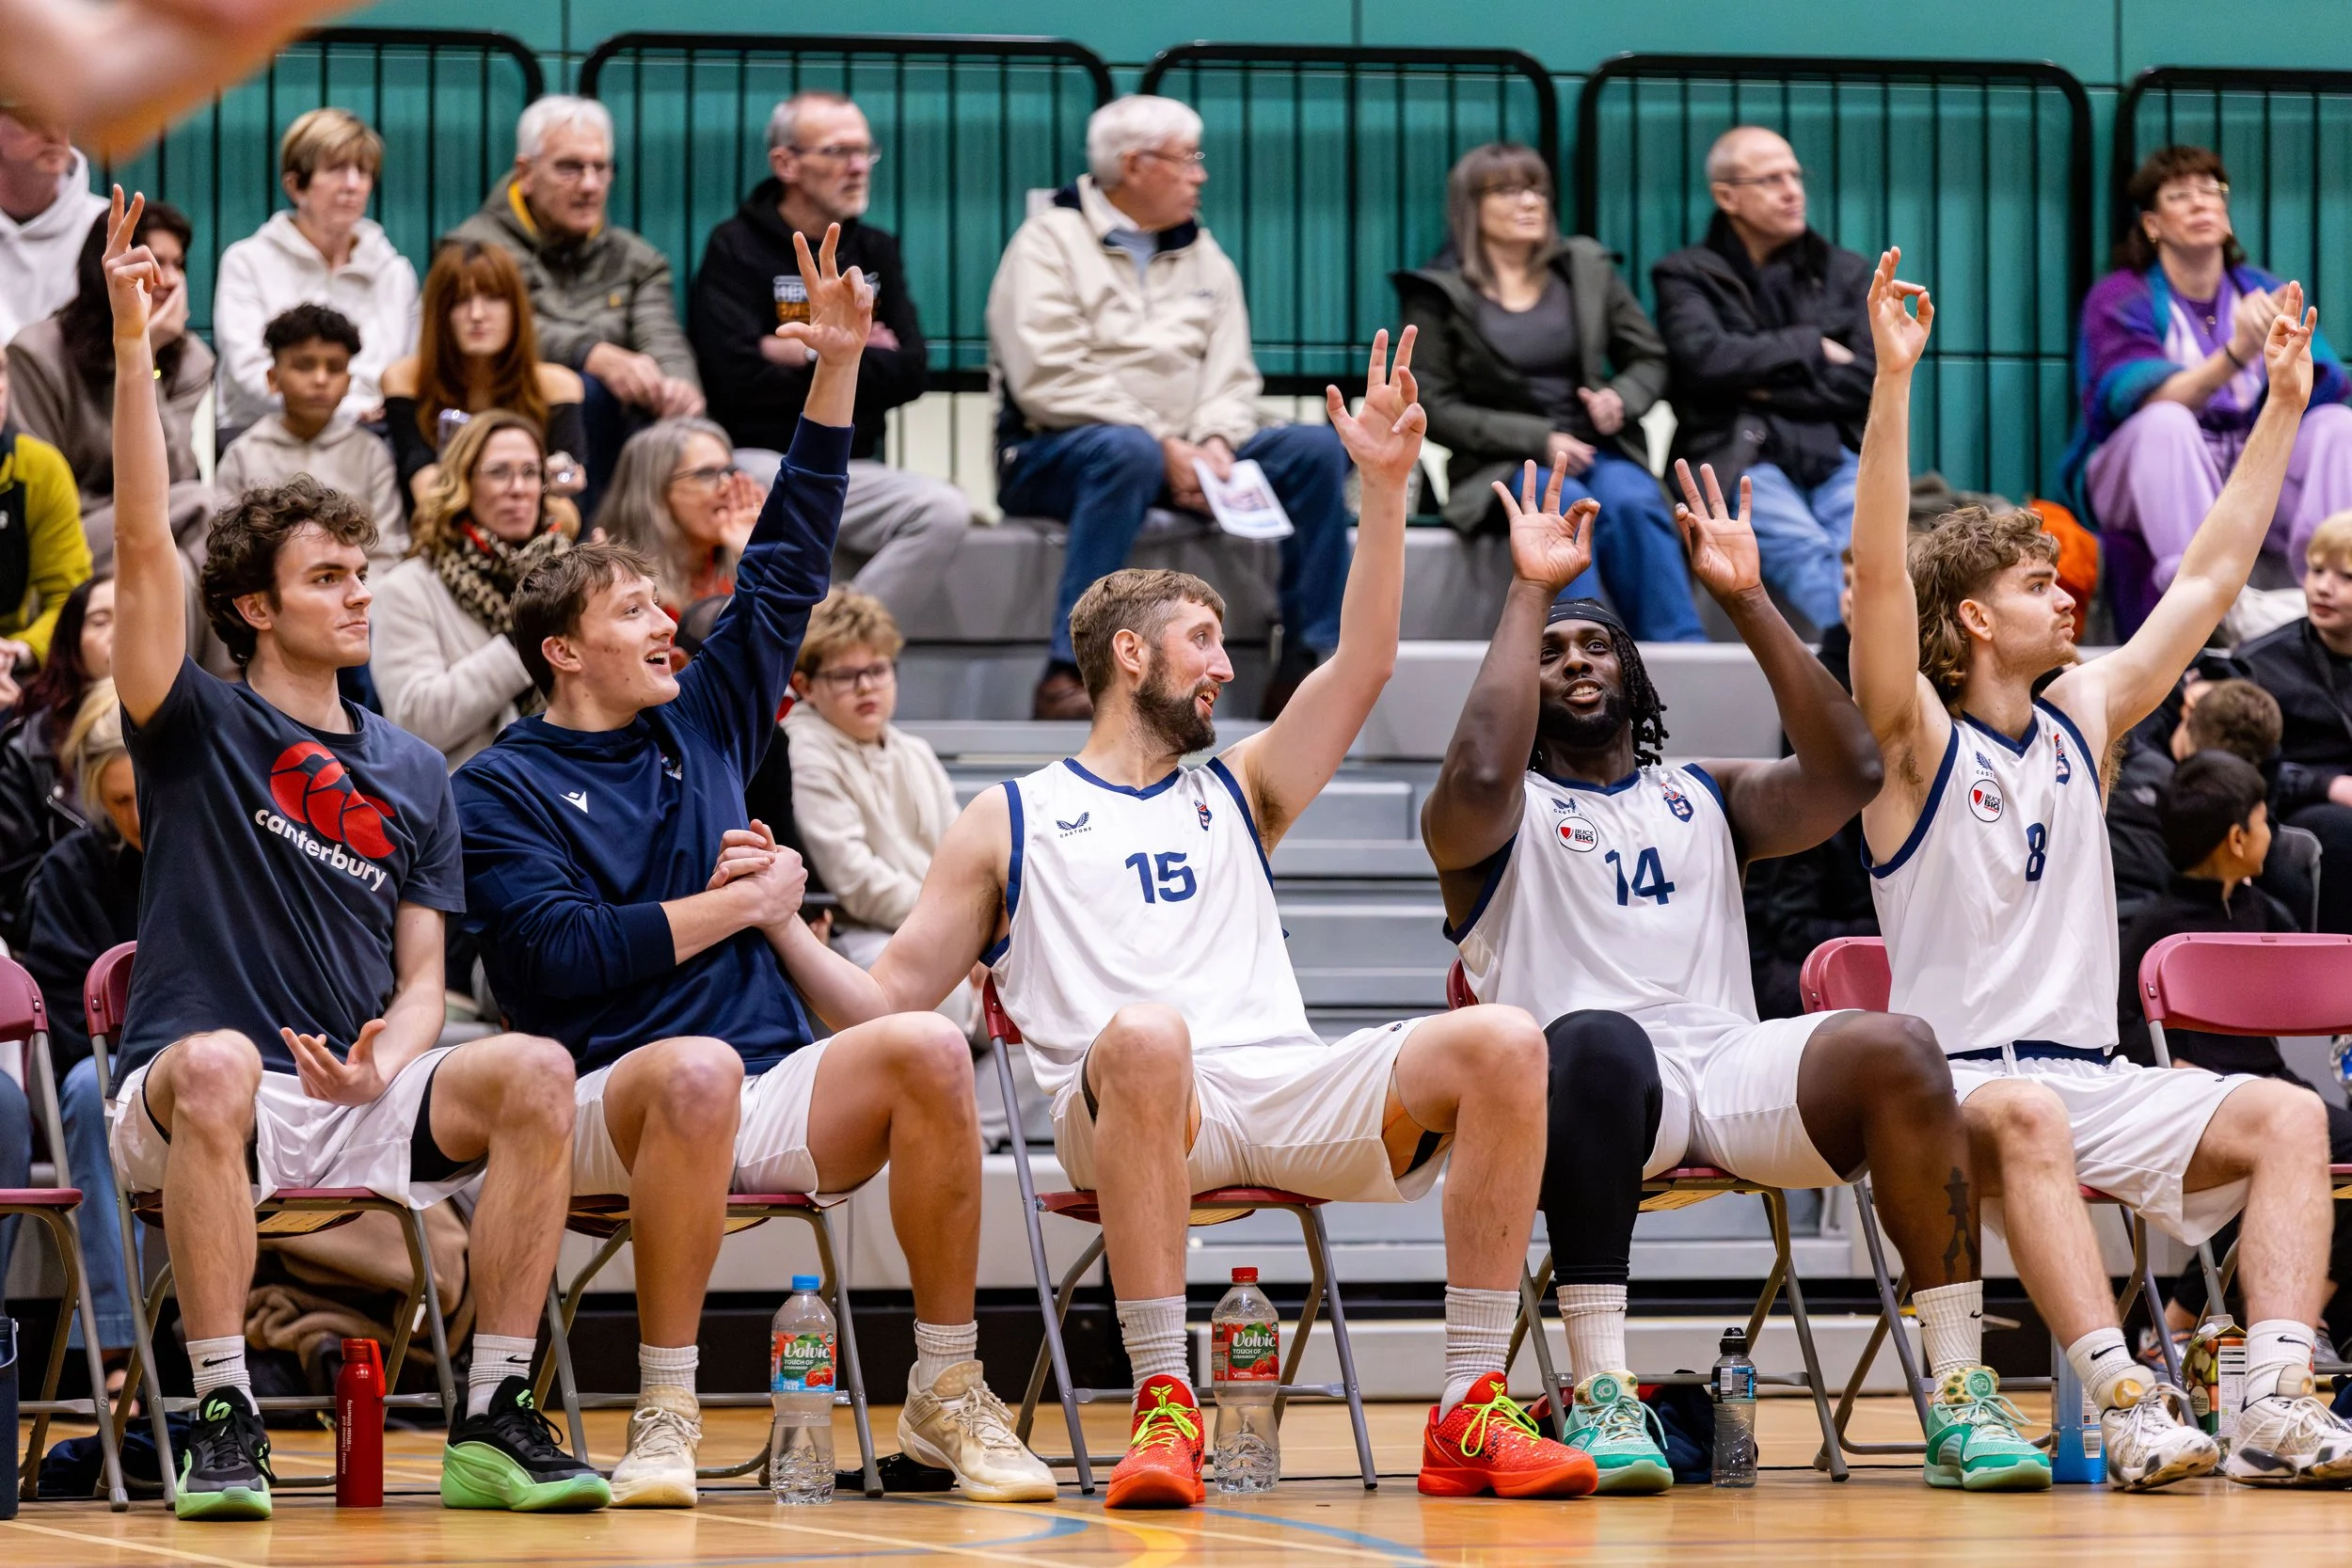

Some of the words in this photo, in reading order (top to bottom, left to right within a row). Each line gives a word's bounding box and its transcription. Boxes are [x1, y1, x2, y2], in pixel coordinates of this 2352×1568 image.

[1984, 800, 2000, 812] BIG
[1985, 793, 2001, 804] BUCS
[1059, 826, 1092, 838] CASTORE
[1575, 833, 1594, 843] BIG
[255, 809, 387, 892] canterbury
[2025, 821, 2046, 882] 8
[1125, 851, 1197, 904] 15
[1604, 847, 1676, 906] 14
[1232, 1331, 1276, 1347] Volvic
[784, 1341, 831, 1358] Volvic
